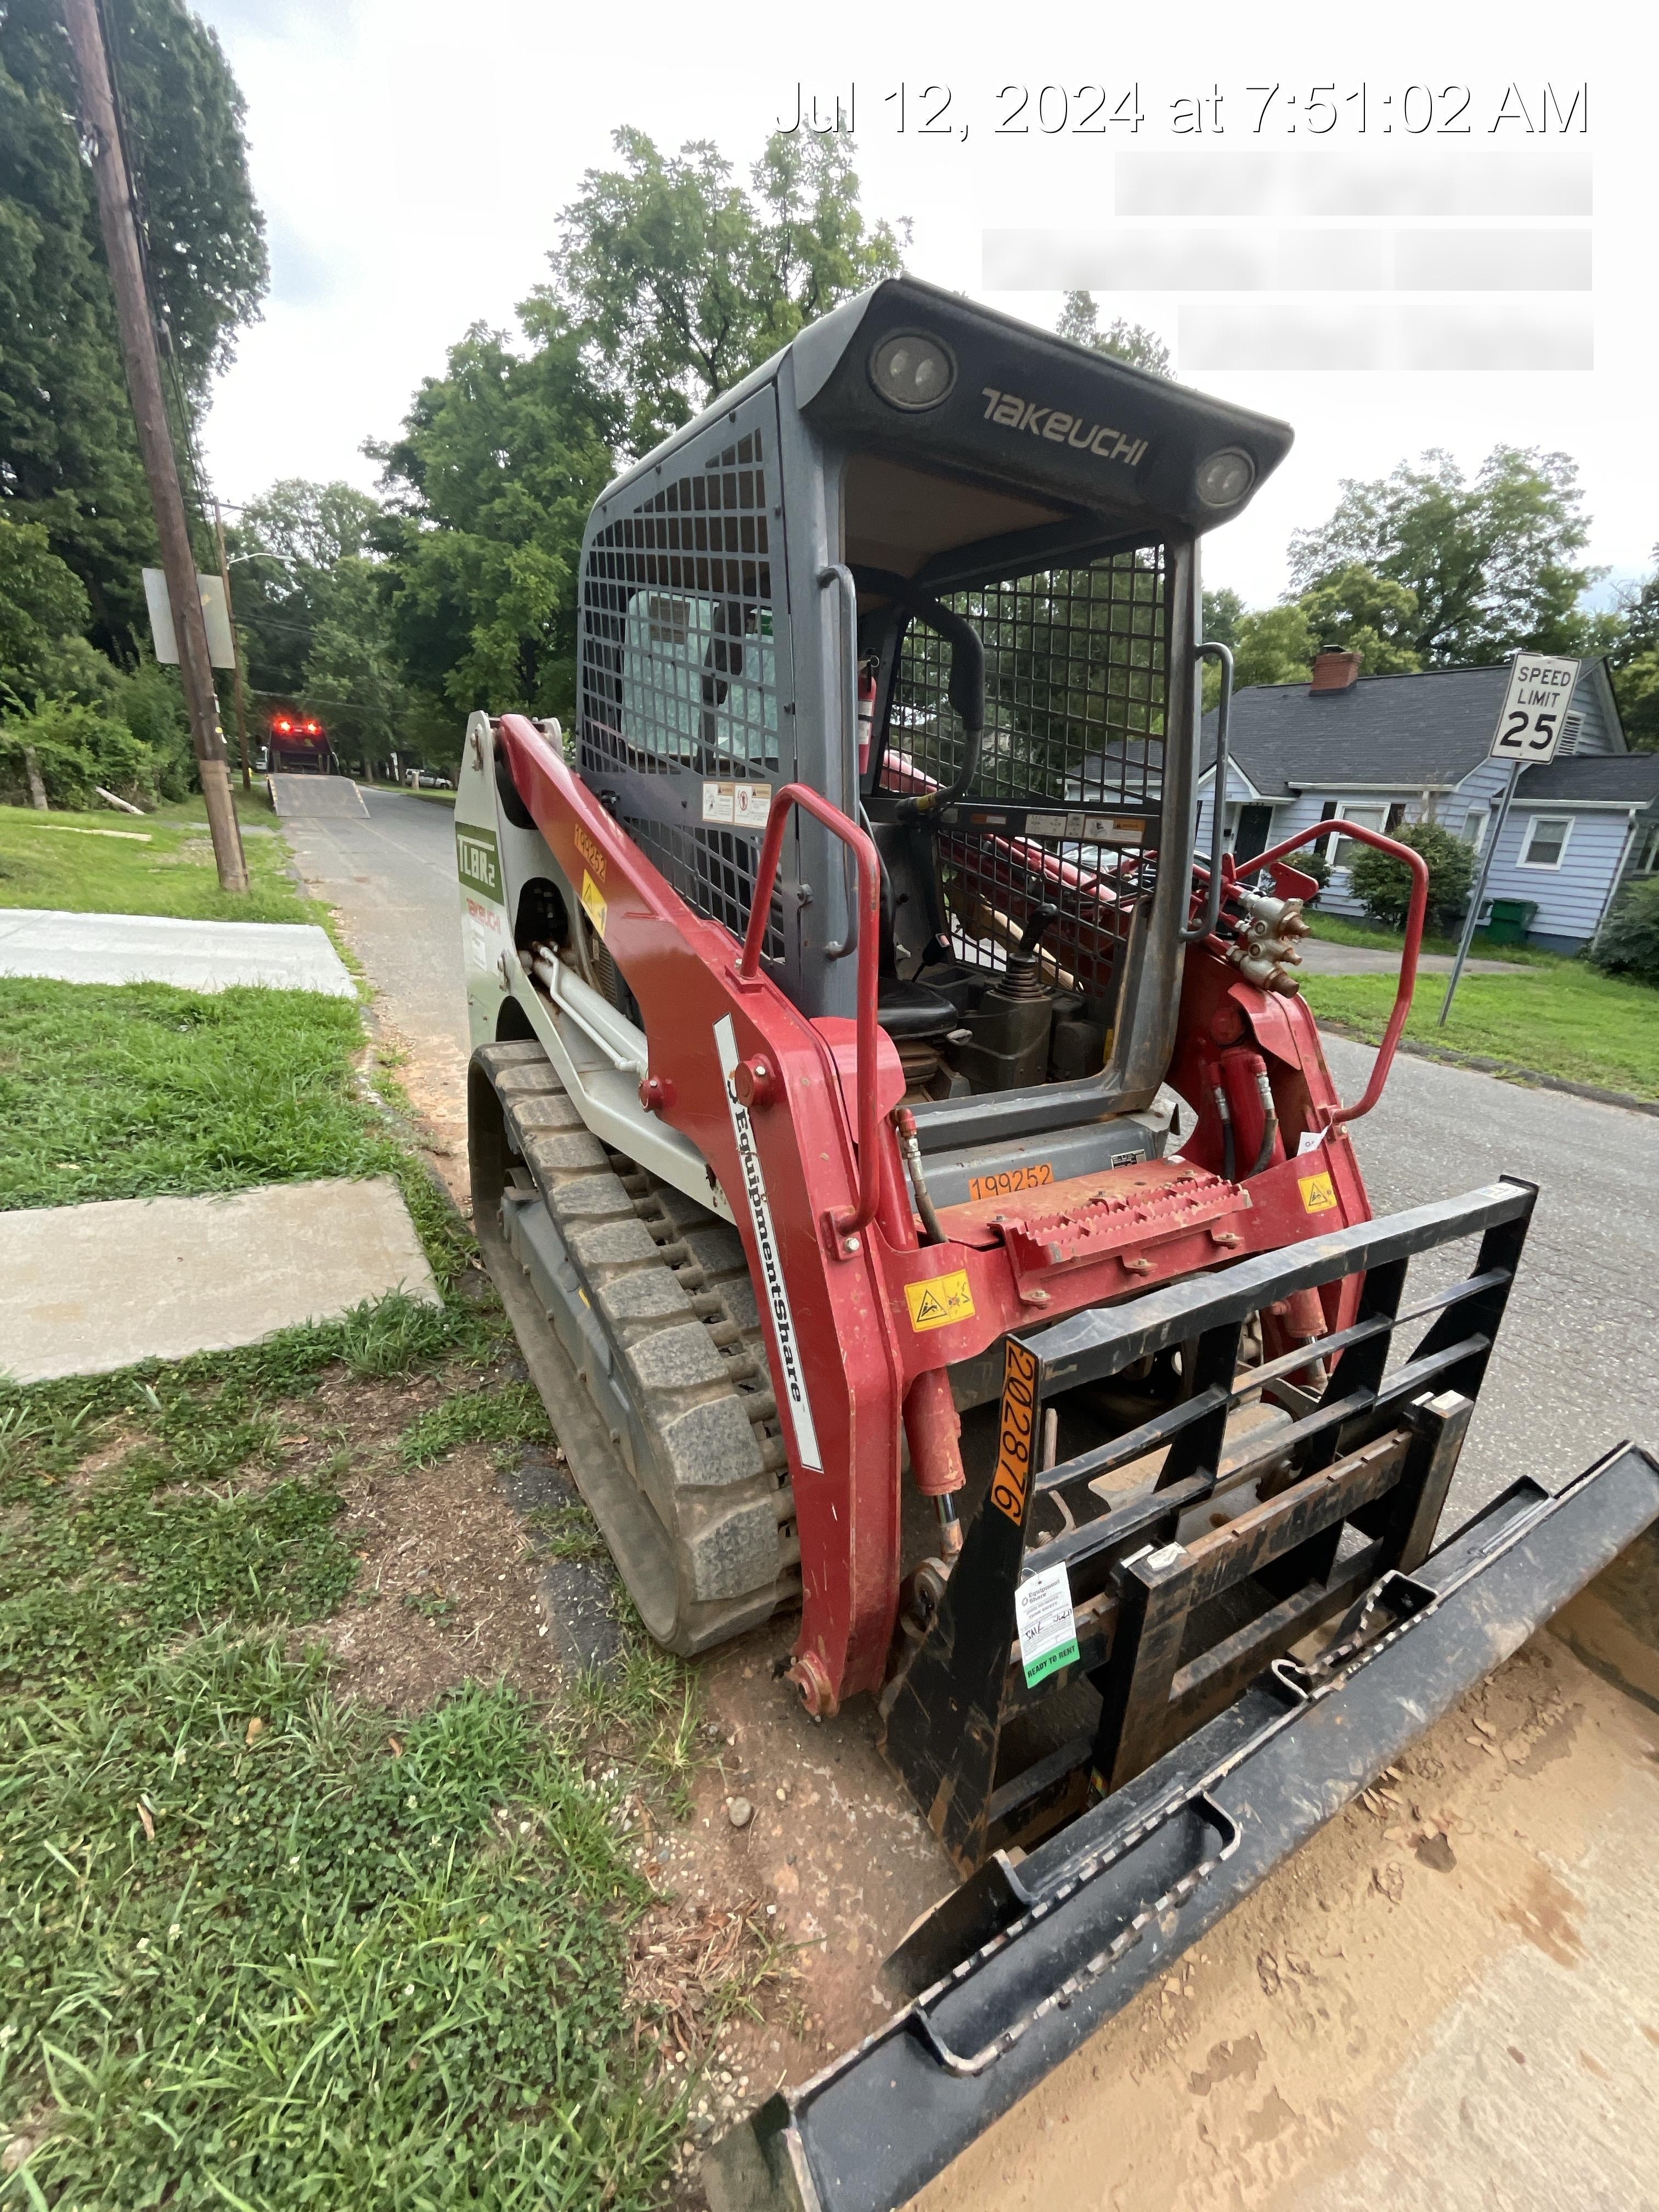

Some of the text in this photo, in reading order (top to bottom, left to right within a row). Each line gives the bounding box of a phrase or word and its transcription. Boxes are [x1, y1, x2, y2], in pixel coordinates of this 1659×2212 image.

[1517, 666, 1571, 687] SPEED
[1517, 688, 1560, 708] LIMIT
[1499, 710, 1557, 750] 25
[576, 827, 605, 882] 199252
[972, 1164, 1051, 1200] 199252
[735, 1108, 801, 1402] EquipmentShare
[994, 1346, 1034, 1518] 202876
[1028, 1579, 1060, 1598] Equipment
[1029, 1592, 1047, 1604] Share
[1028, 1645, 1075, 1678] READY TO RENT
